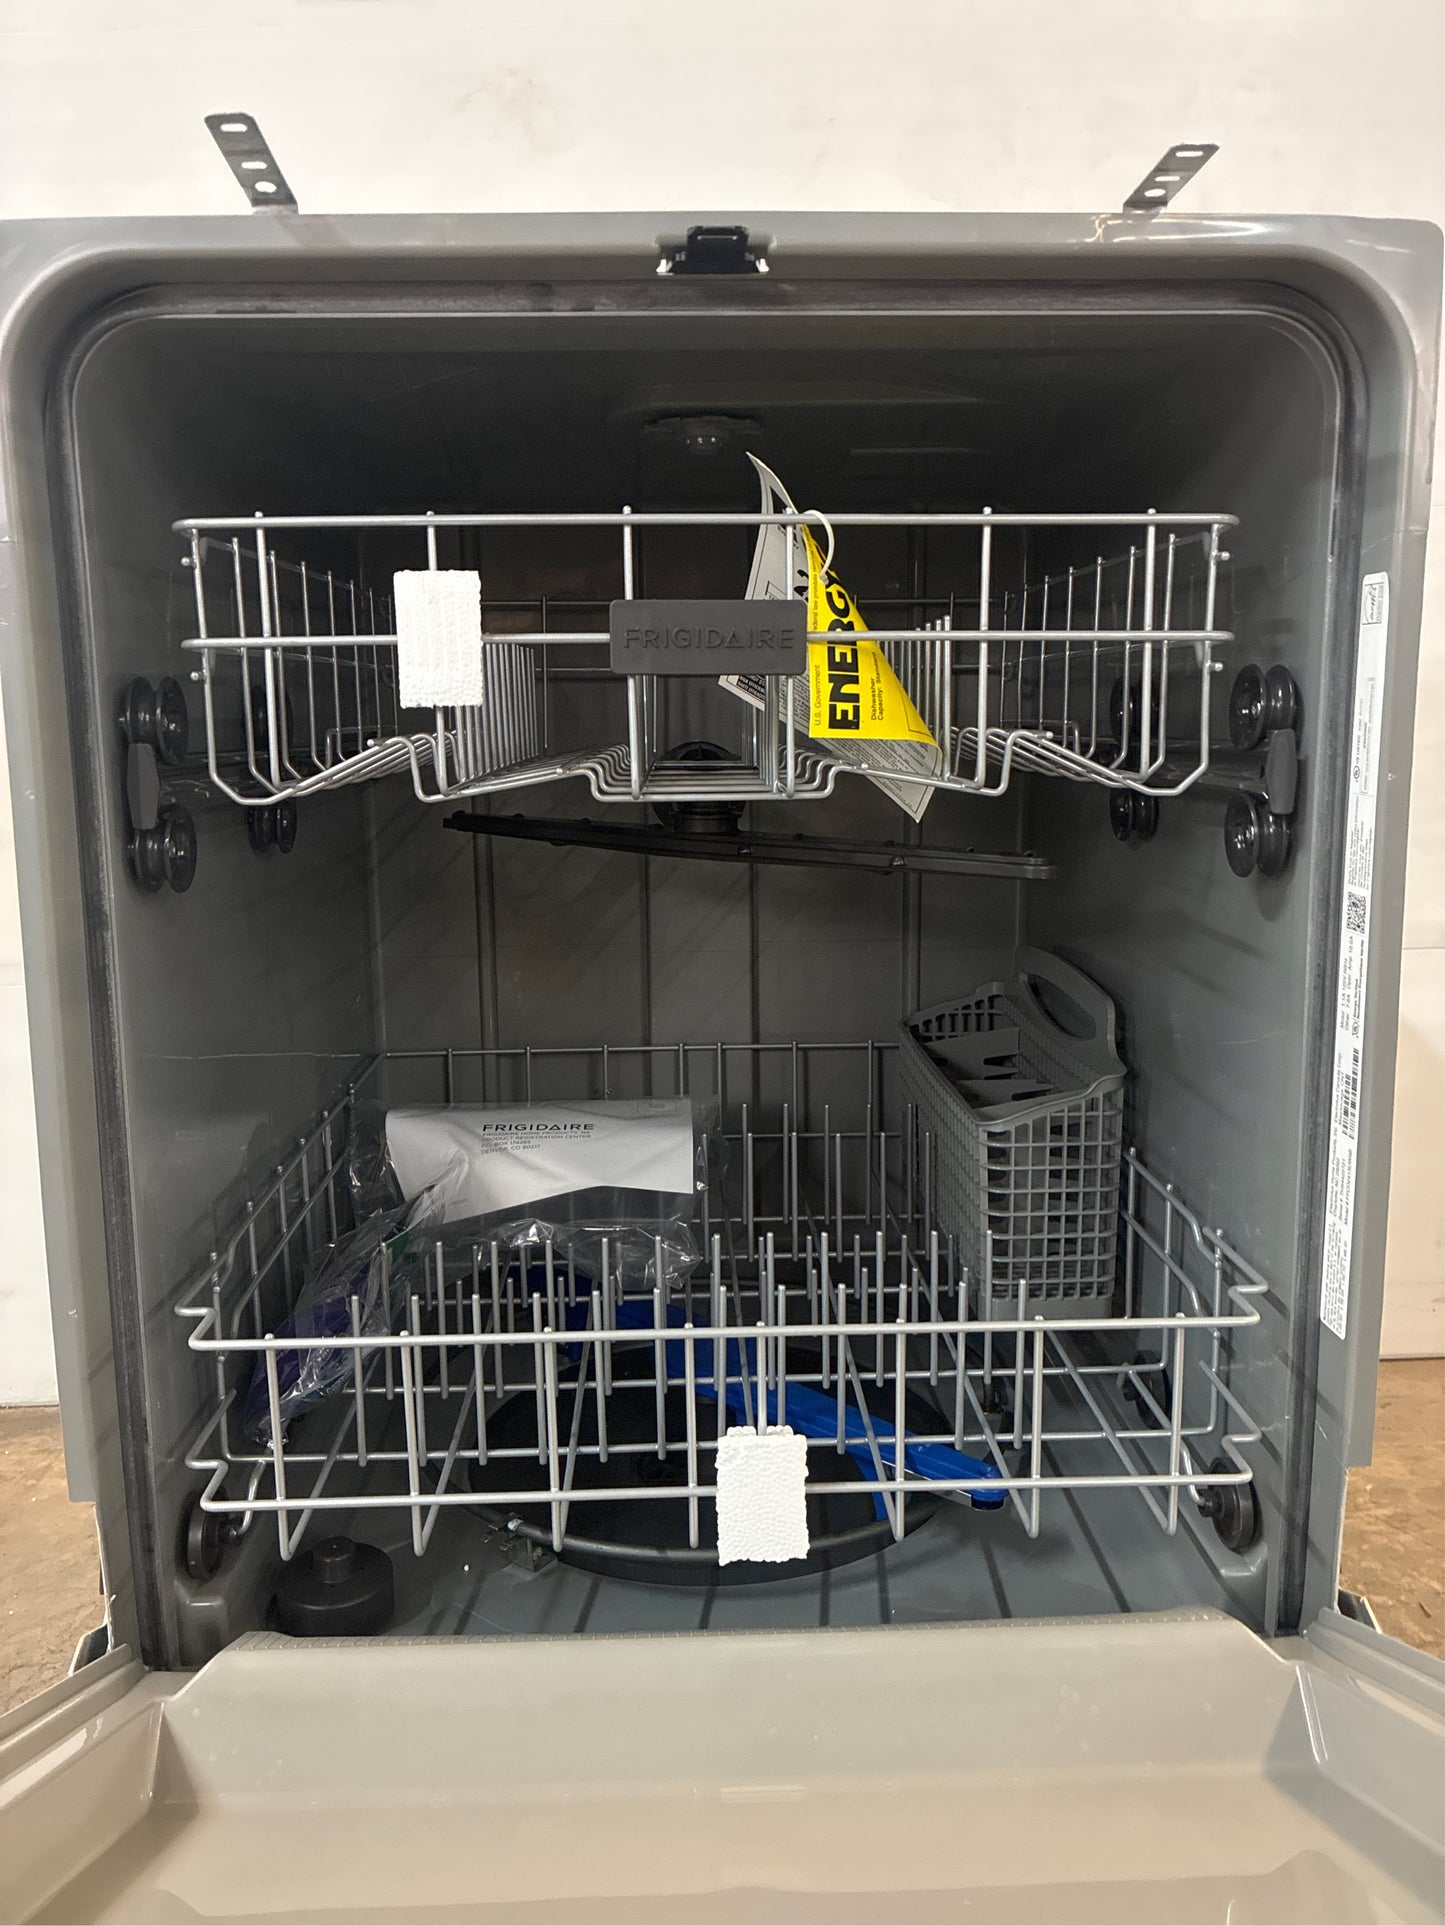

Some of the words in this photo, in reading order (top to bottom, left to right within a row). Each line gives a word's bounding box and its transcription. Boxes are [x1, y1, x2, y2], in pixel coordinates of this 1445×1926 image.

[624, 628, 795, 649] FRIGIDAIRE
[813, 664, 822, 709] Government
[814, 710, 822, 726] U.S.
[483, 1124, 594, 1132] FRIGIDAIRE
